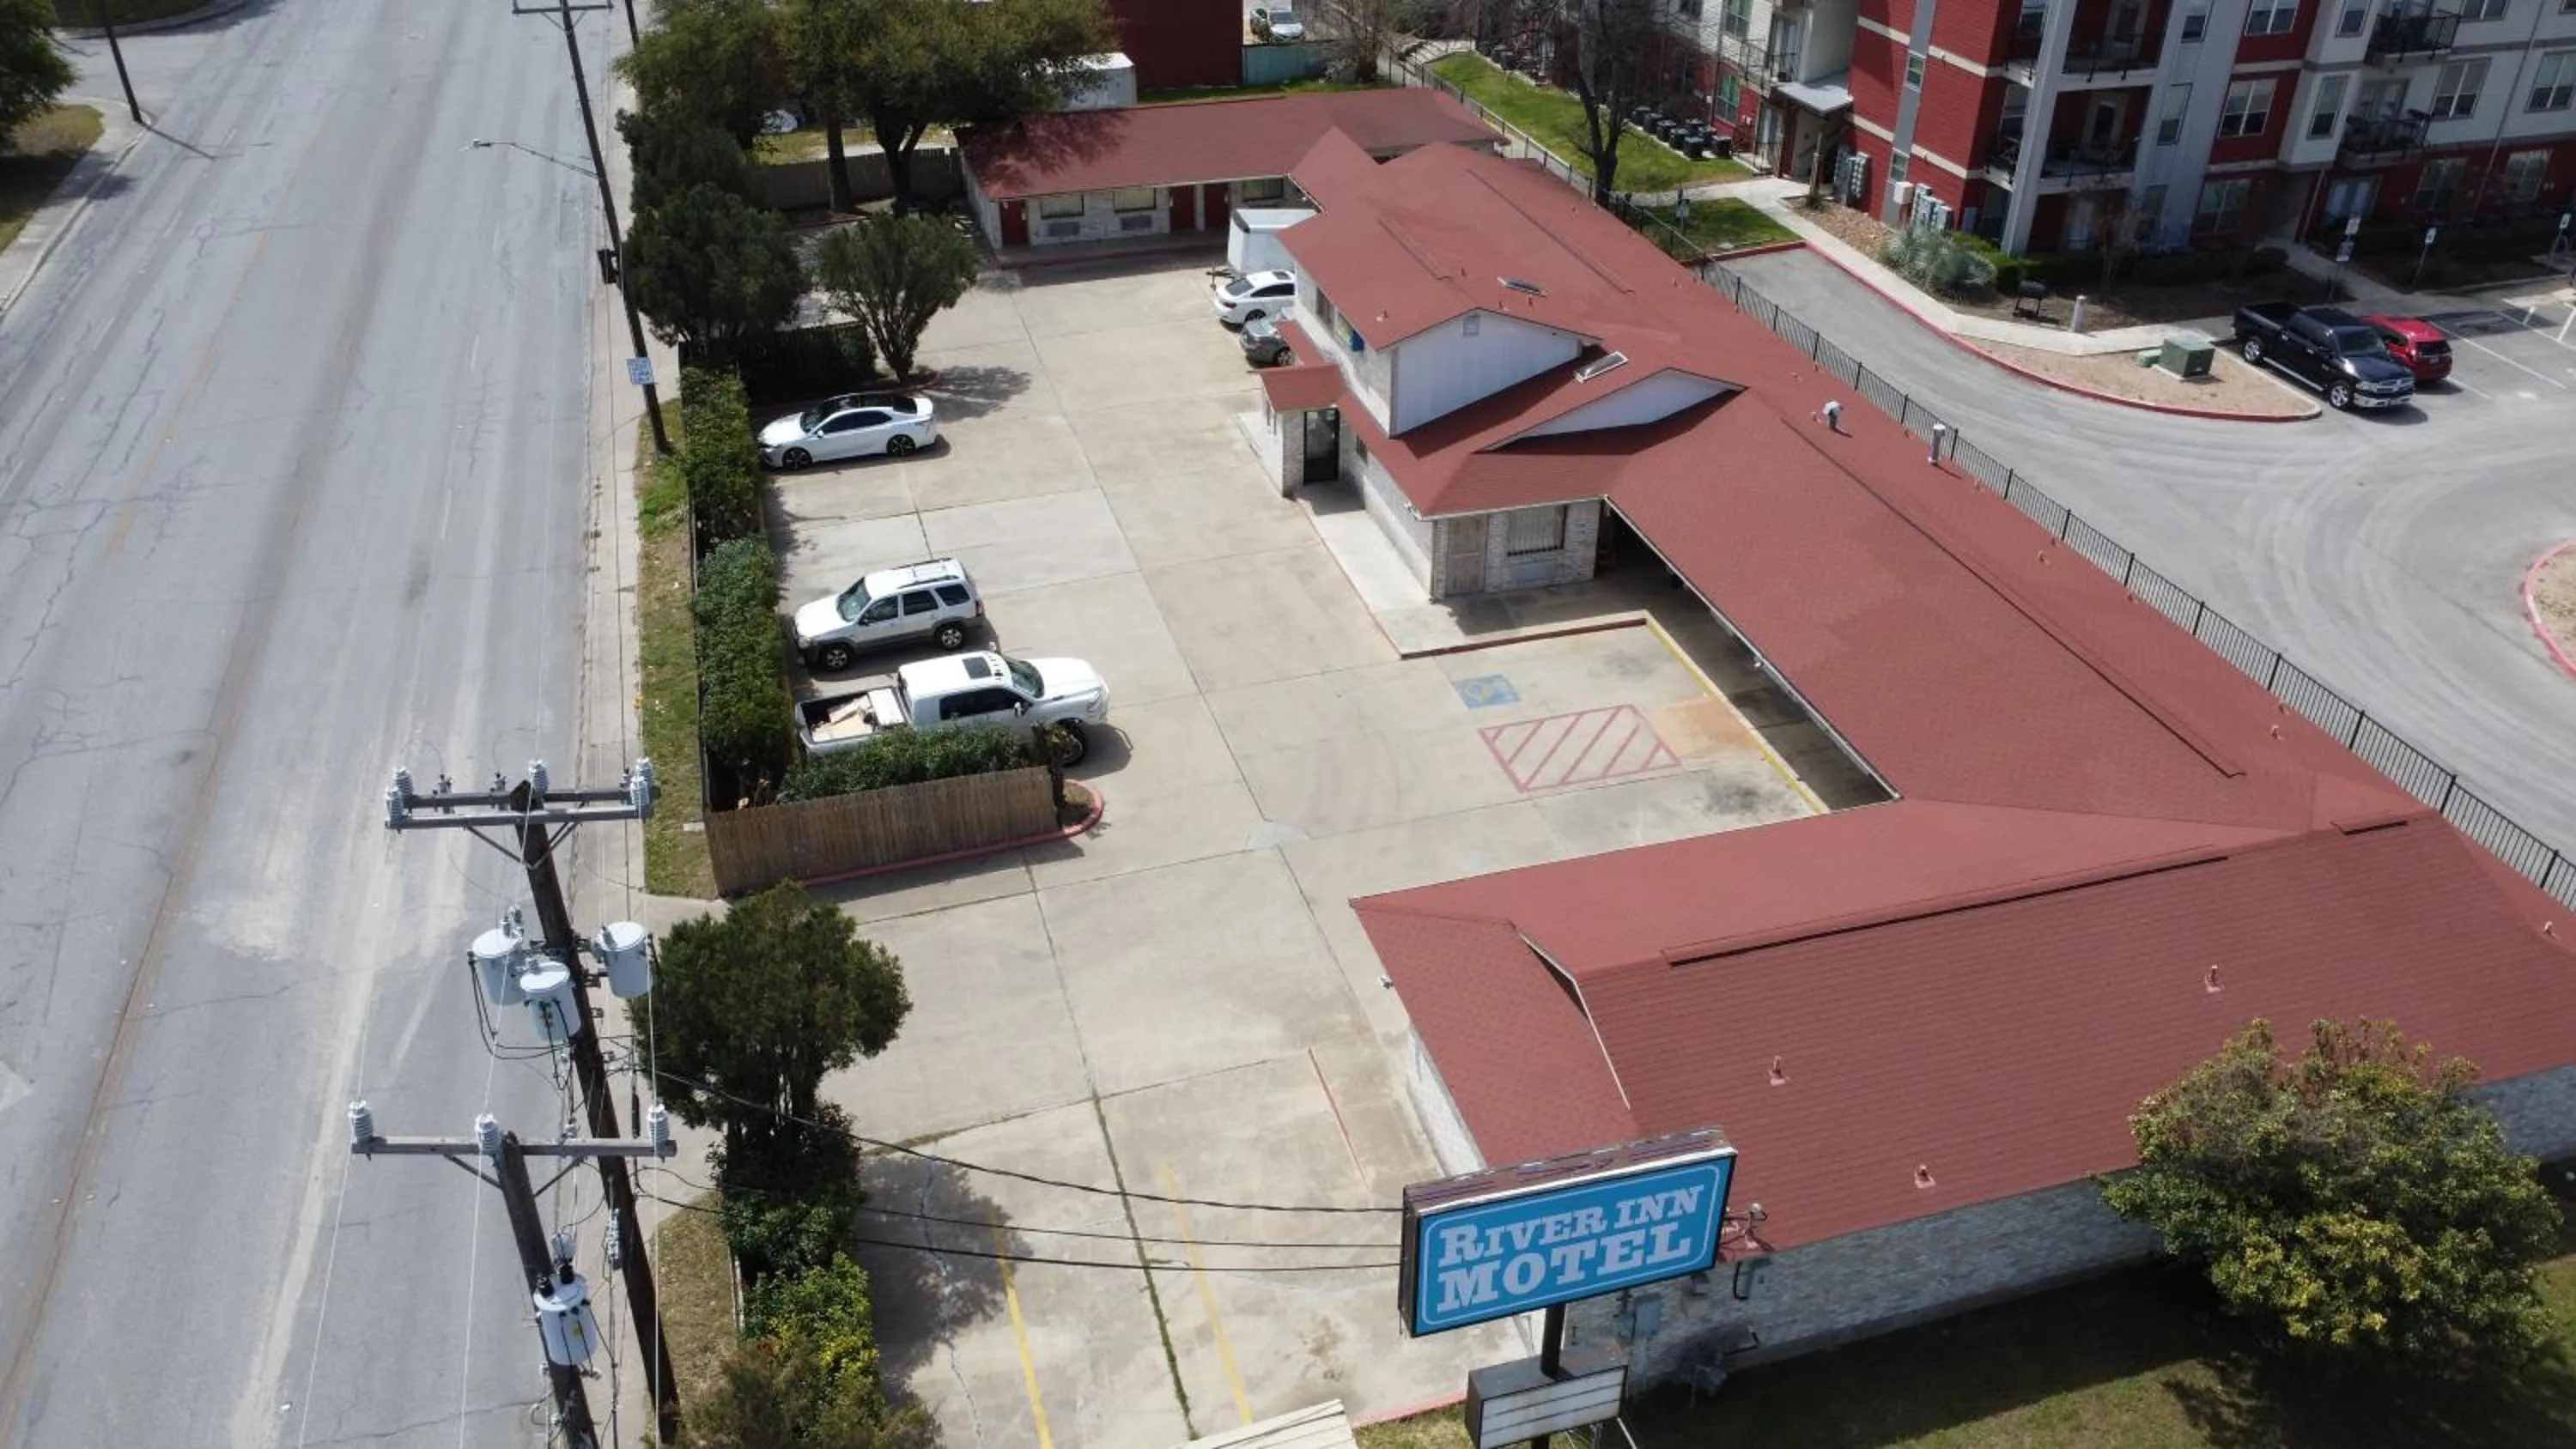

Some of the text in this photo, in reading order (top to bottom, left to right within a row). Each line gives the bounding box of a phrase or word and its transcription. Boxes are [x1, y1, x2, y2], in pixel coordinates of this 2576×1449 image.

[1437, 1222, 1692, 1313] MOTEL
[1438, 1185, 1704, 1267] RIVER INN
